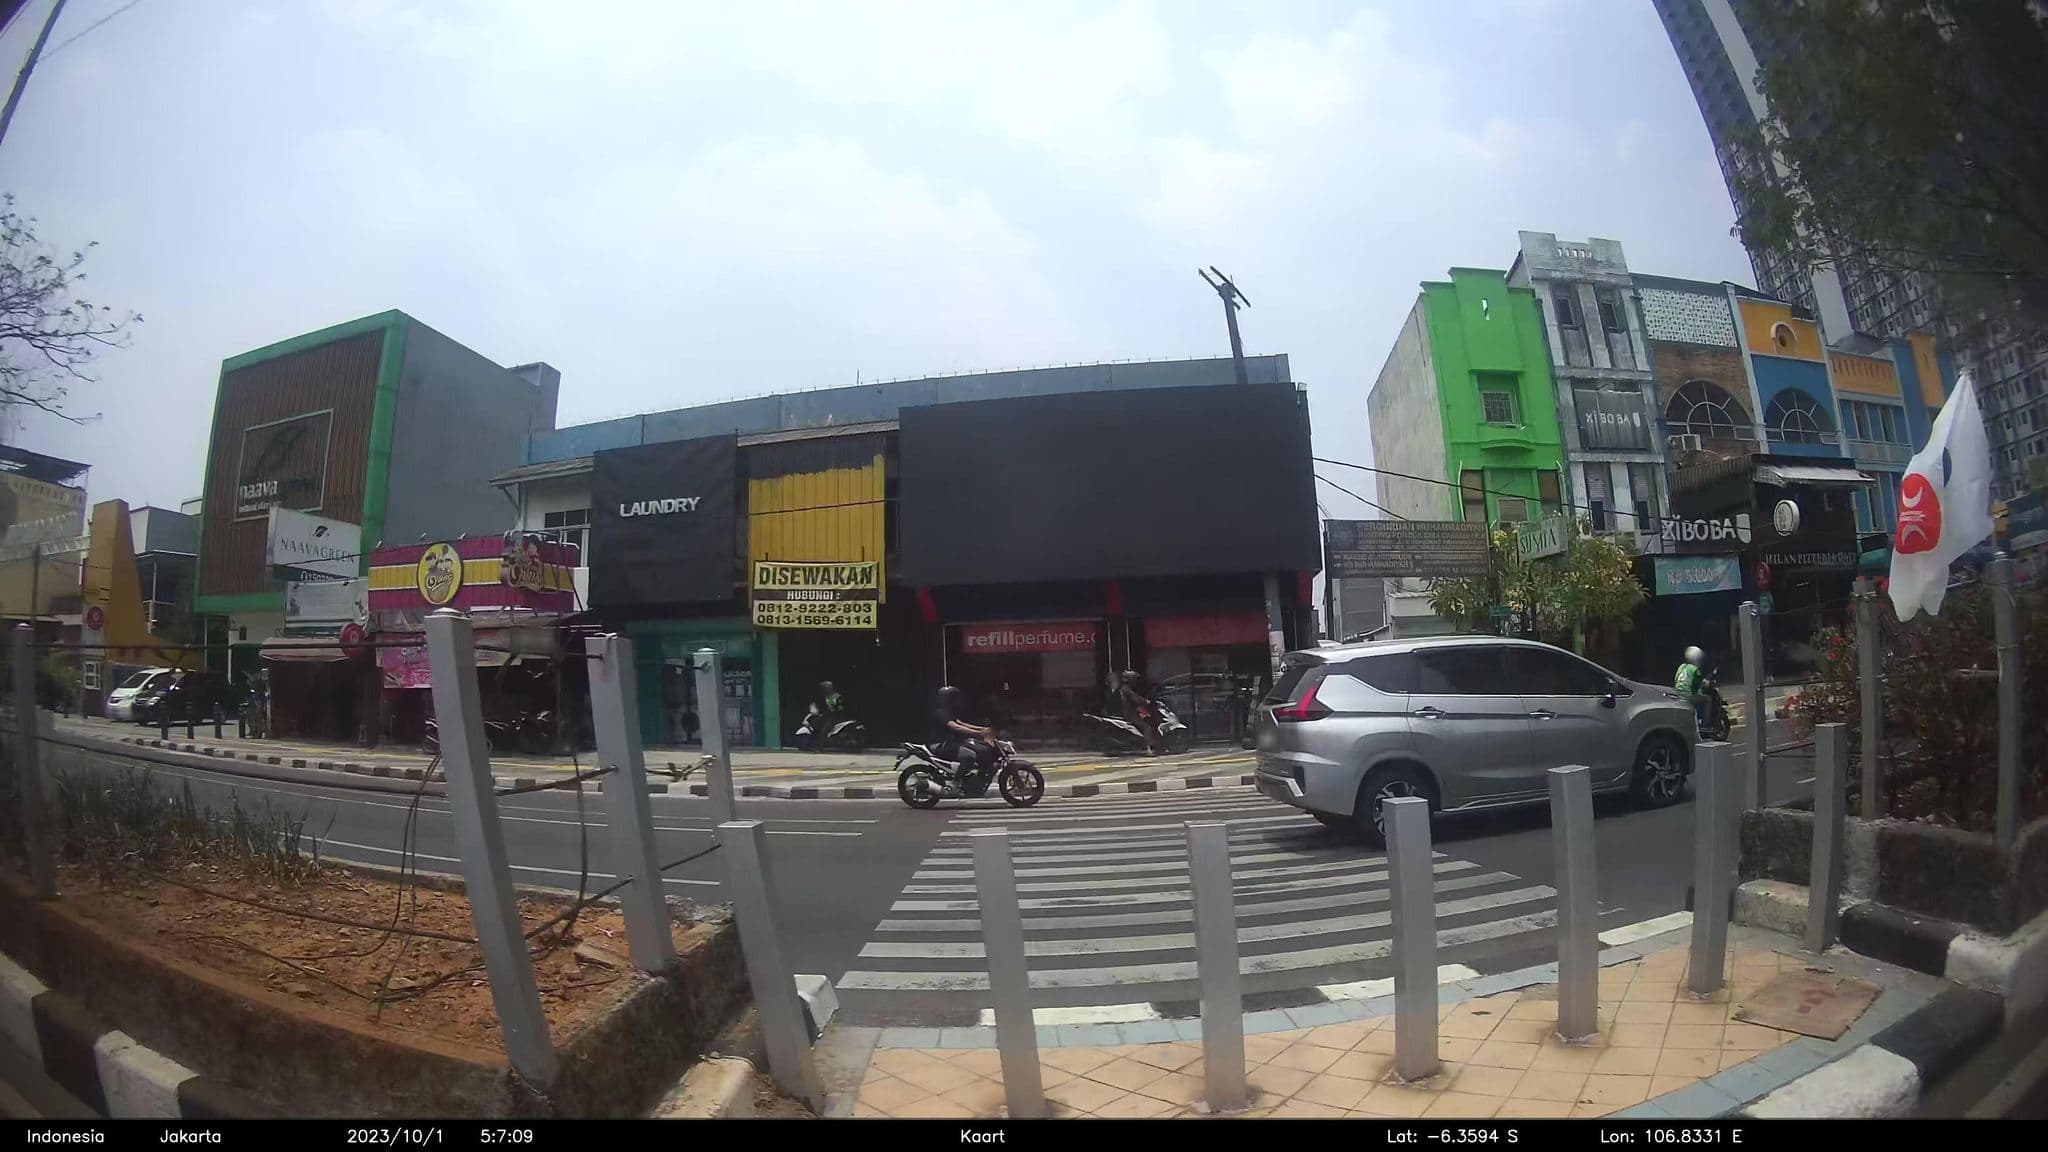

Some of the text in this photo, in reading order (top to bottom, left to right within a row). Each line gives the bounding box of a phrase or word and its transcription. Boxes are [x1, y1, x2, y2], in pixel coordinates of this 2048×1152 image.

[620, 496, 701, 517] LAUNDRY
[281, 538, 355, 564] NAAVAGREEN
[759, 565, 873, 586] DISEWAKAN
[787, 591, 834, 600] HUBUNGI
[758, 603, 873, 614] 0812-9222-803
[757, 615, 873, 626] 0813-1569-6114
